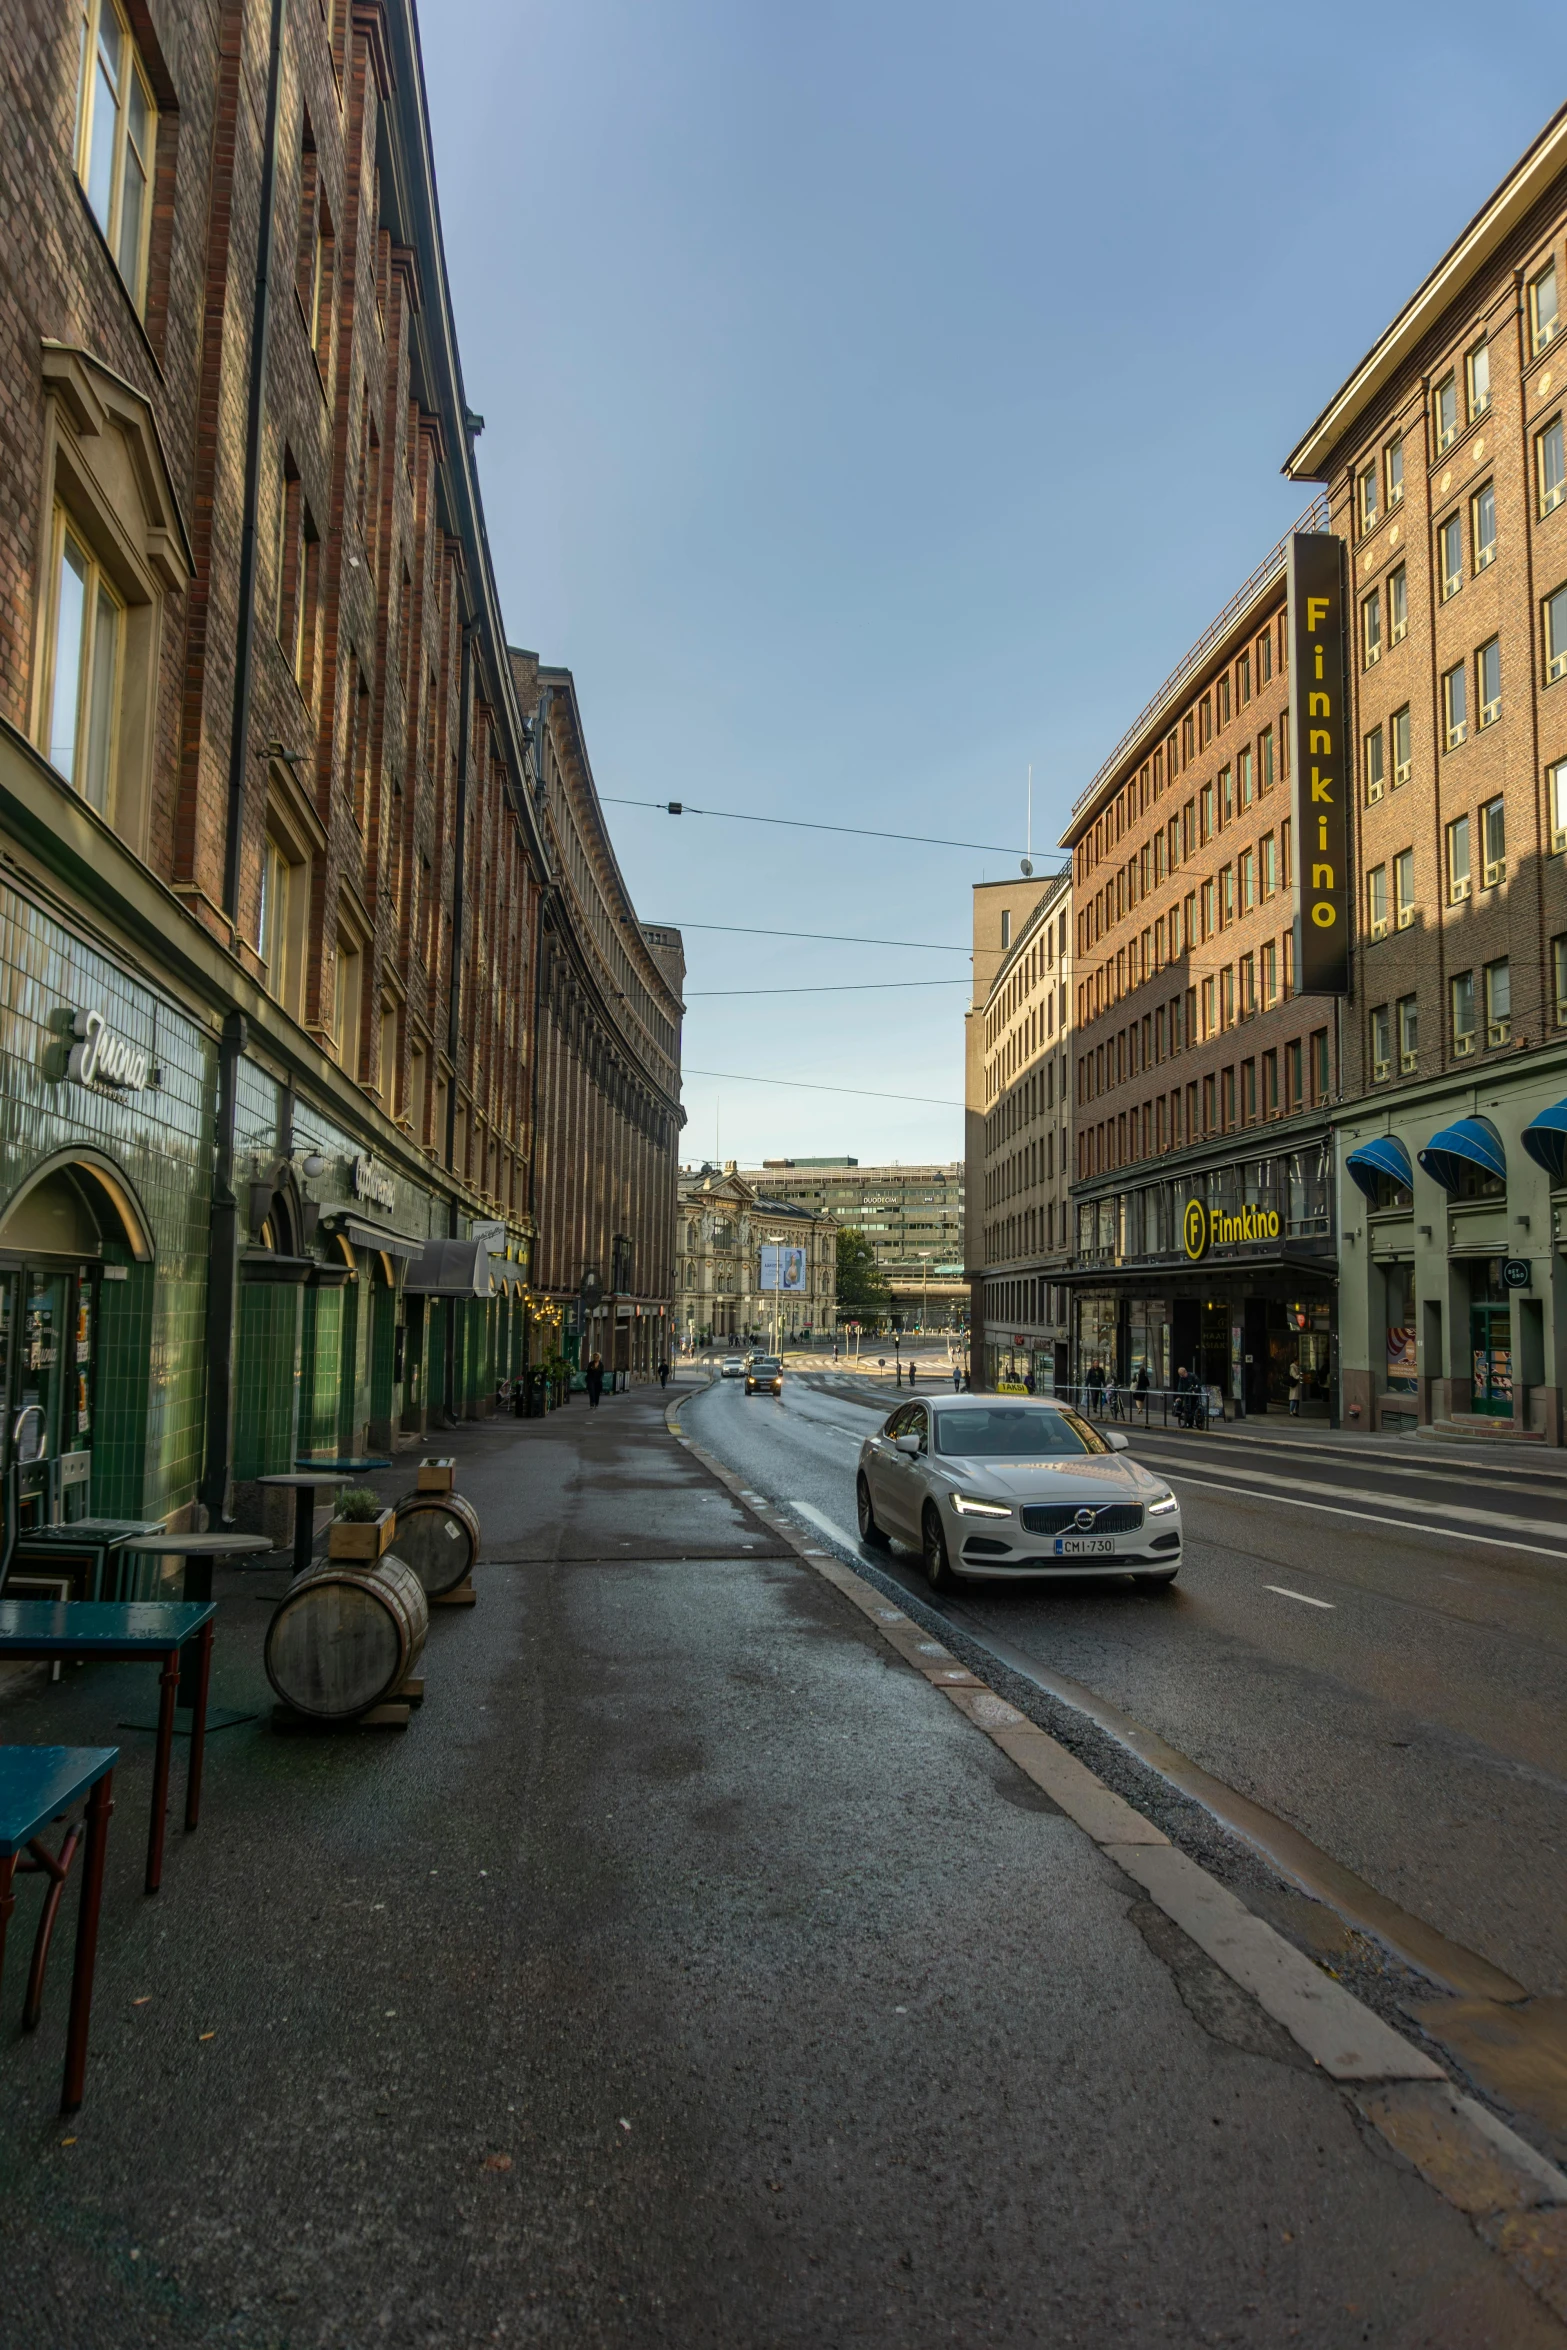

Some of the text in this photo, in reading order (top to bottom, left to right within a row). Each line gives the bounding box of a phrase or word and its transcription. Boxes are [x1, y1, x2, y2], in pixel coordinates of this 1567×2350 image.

[1307, 597, 1336, 928] Finnkino
[1210, 1203, 1279, 1244] Finnkino
[1001, 1383, 1025, 1392] TAKSI
[1064, 1541, 1112, 1553] CMI-730
